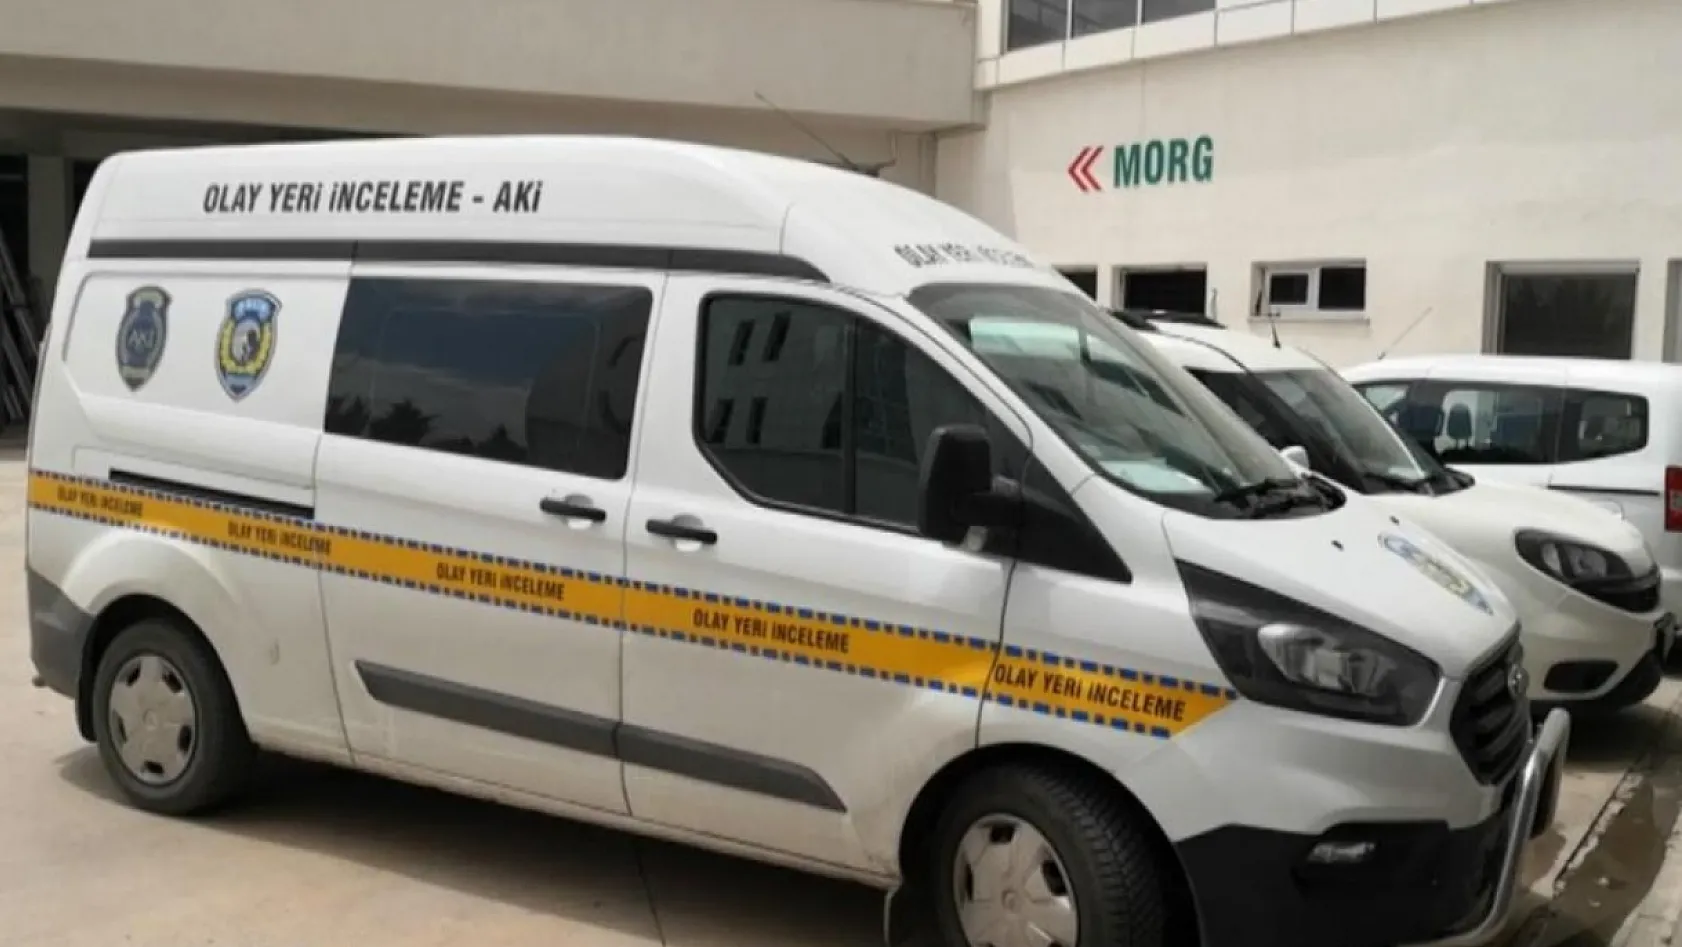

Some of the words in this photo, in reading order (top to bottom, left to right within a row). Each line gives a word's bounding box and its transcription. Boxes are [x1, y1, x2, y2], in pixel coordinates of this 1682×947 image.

[1113, 135, 1214, 188] MORG
[202, 182, 263, 213] OLAY
[693, 608, 730, 631] OLAY
[994, 663, 1039, 690] OLAY
